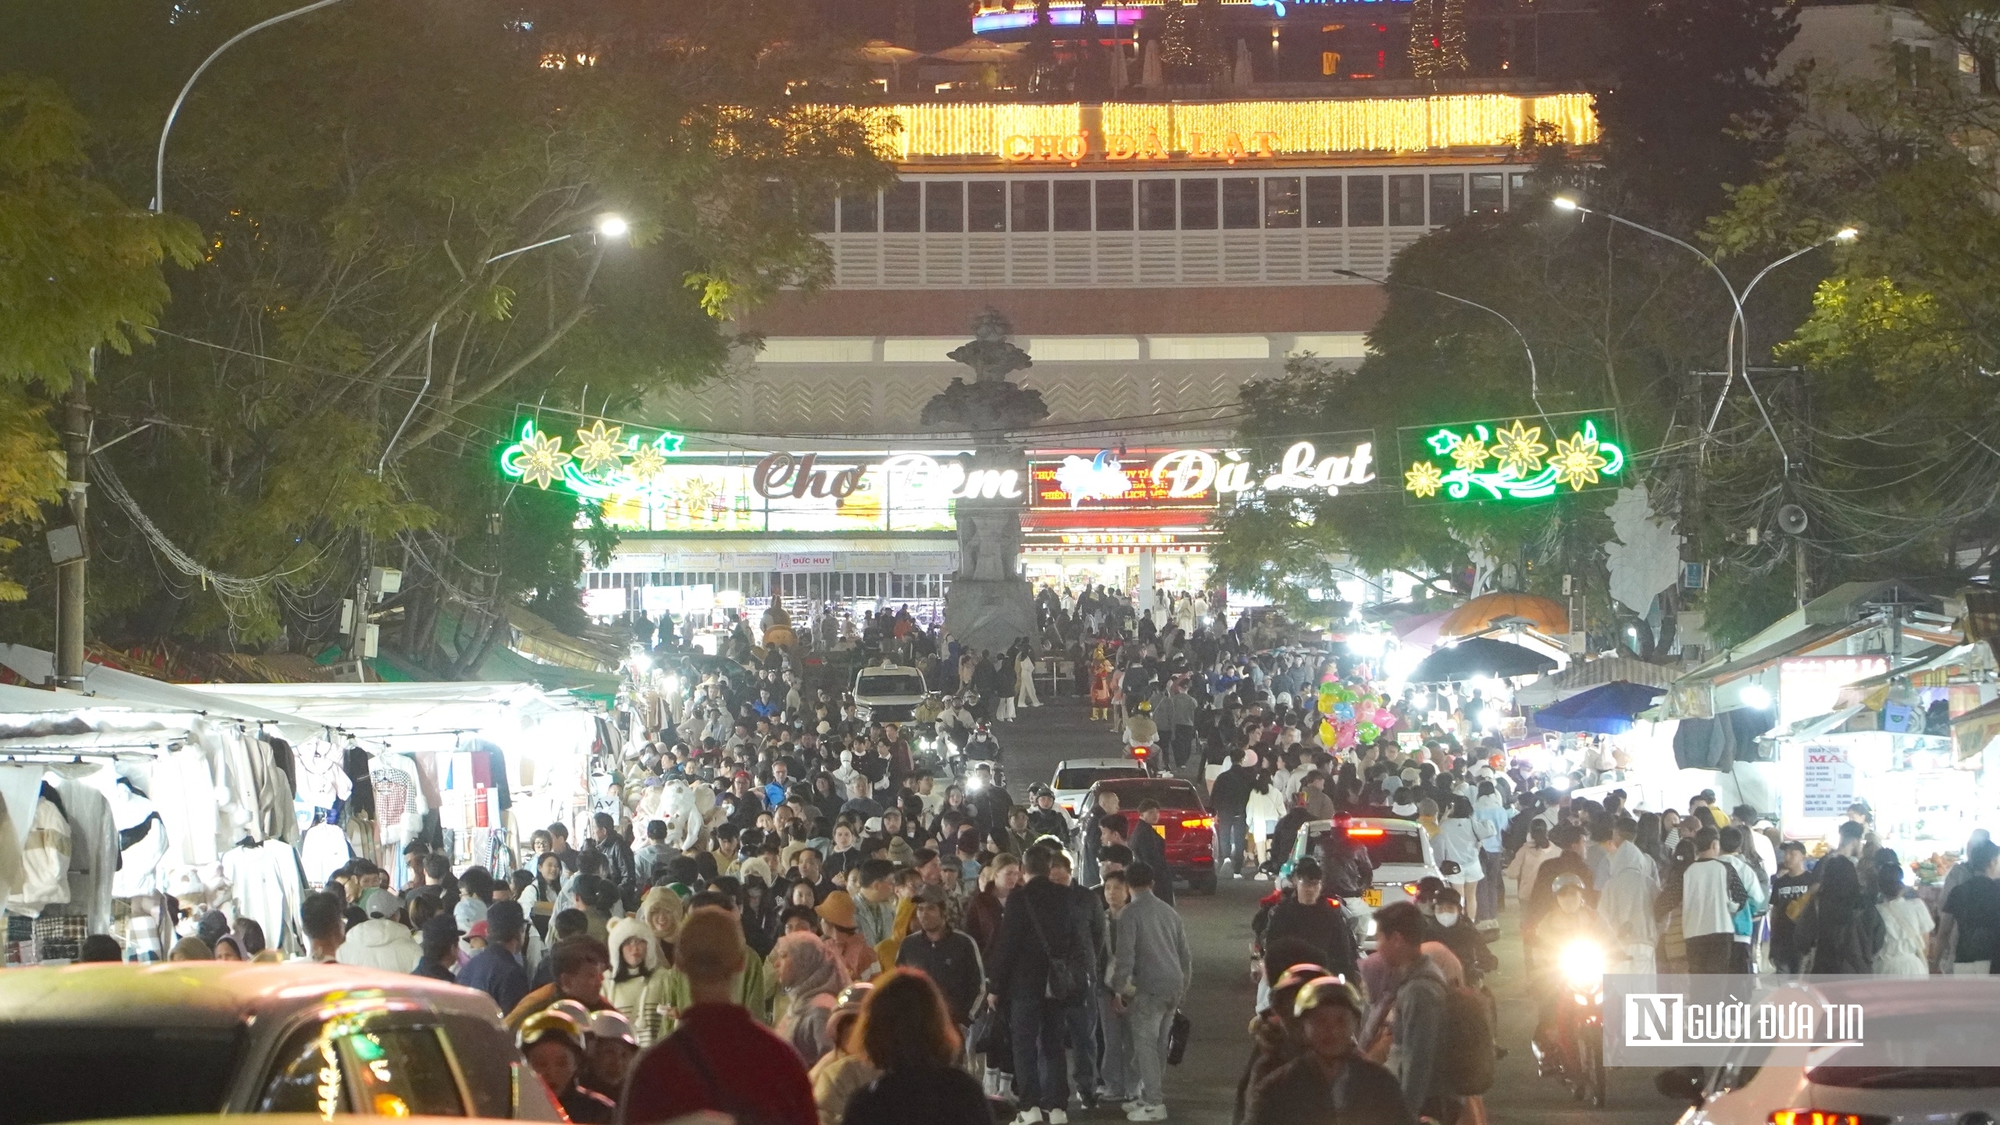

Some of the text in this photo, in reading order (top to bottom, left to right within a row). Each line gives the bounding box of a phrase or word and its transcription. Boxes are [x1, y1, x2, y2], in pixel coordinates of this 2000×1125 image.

[1003, 126, 1277, 168] CHỢ ĐÀ LẠT
[753, 451, 866, 508] Chợ
[1152, 449, 1255, 497] Đà
[1263, 441, 1375, 496] Lạt
[792, 556, 811, 564] ĐỨC
